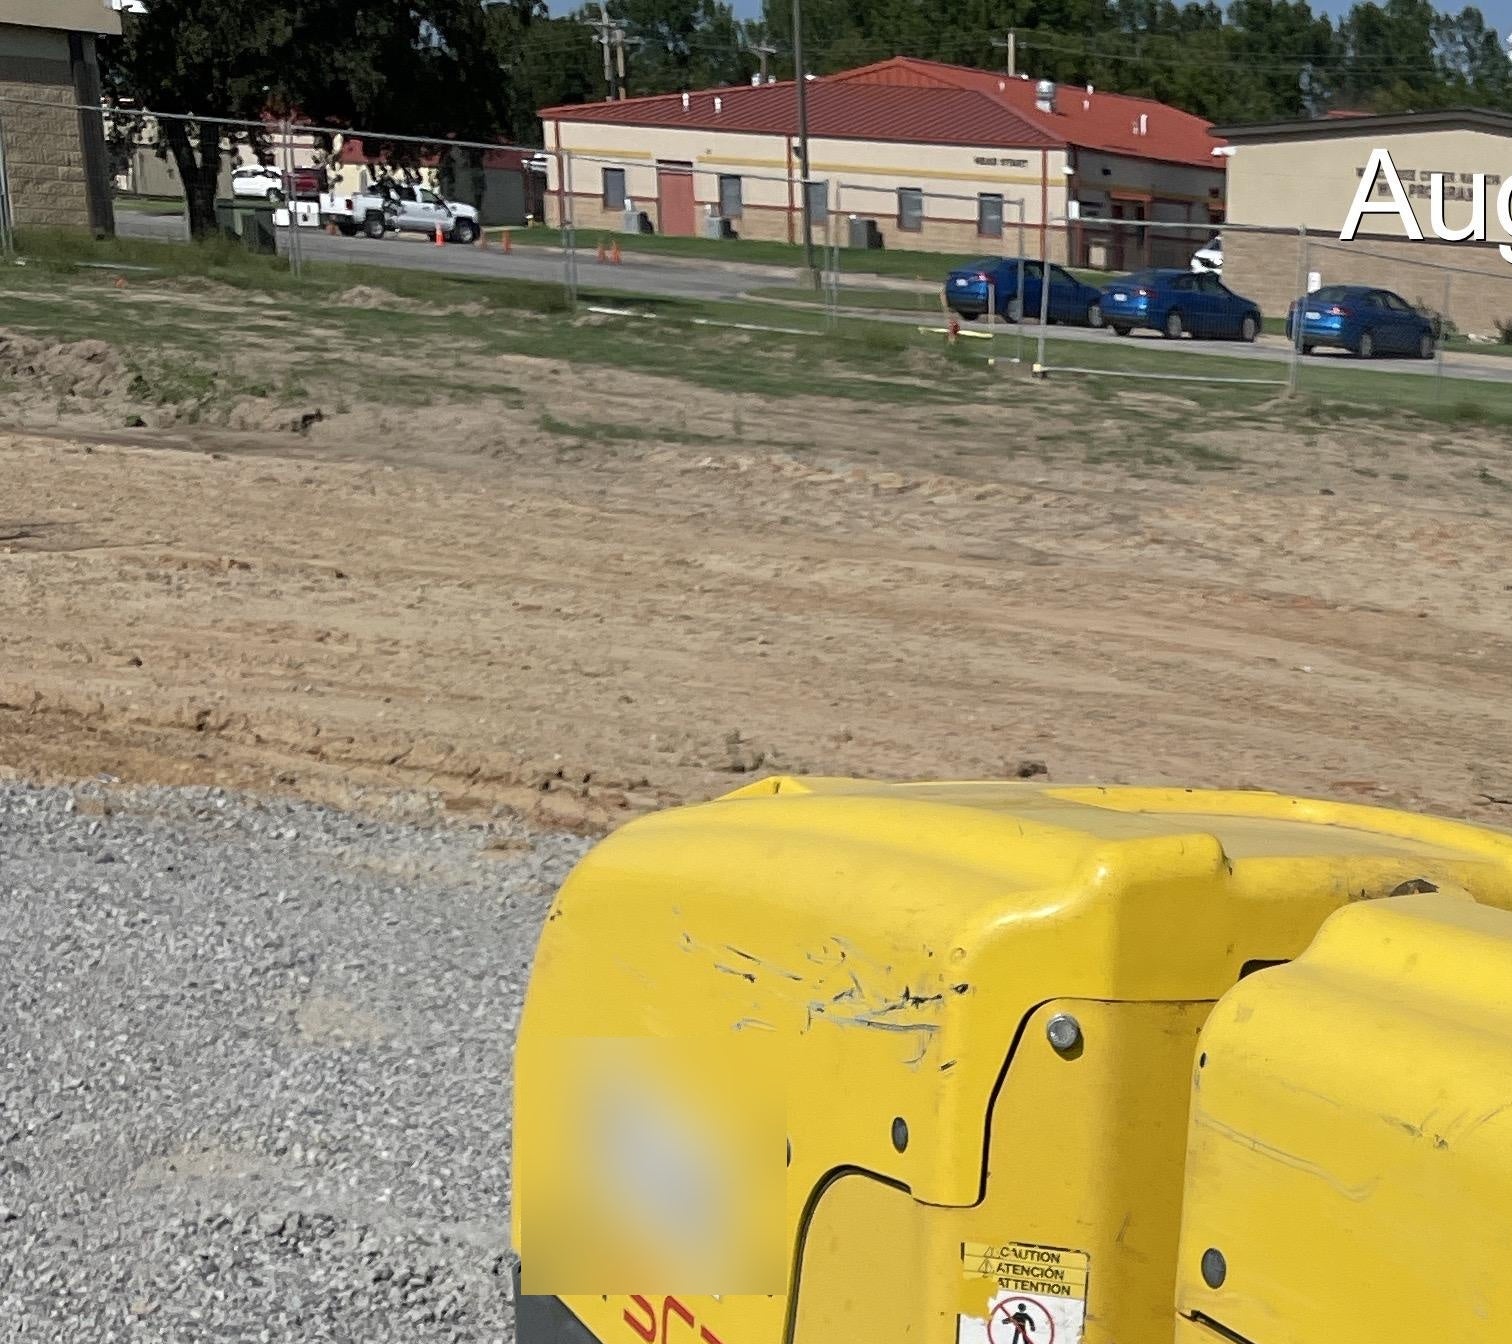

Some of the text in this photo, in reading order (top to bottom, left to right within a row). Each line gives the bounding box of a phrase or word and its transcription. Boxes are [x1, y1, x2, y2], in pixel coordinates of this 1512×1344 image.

[1000, 1246, 1061, 1265] CAUTION
[996, 1263, 1065, 1281] ATENCIÓN
[998, 1277, 1071, 1296] ATTENTION
